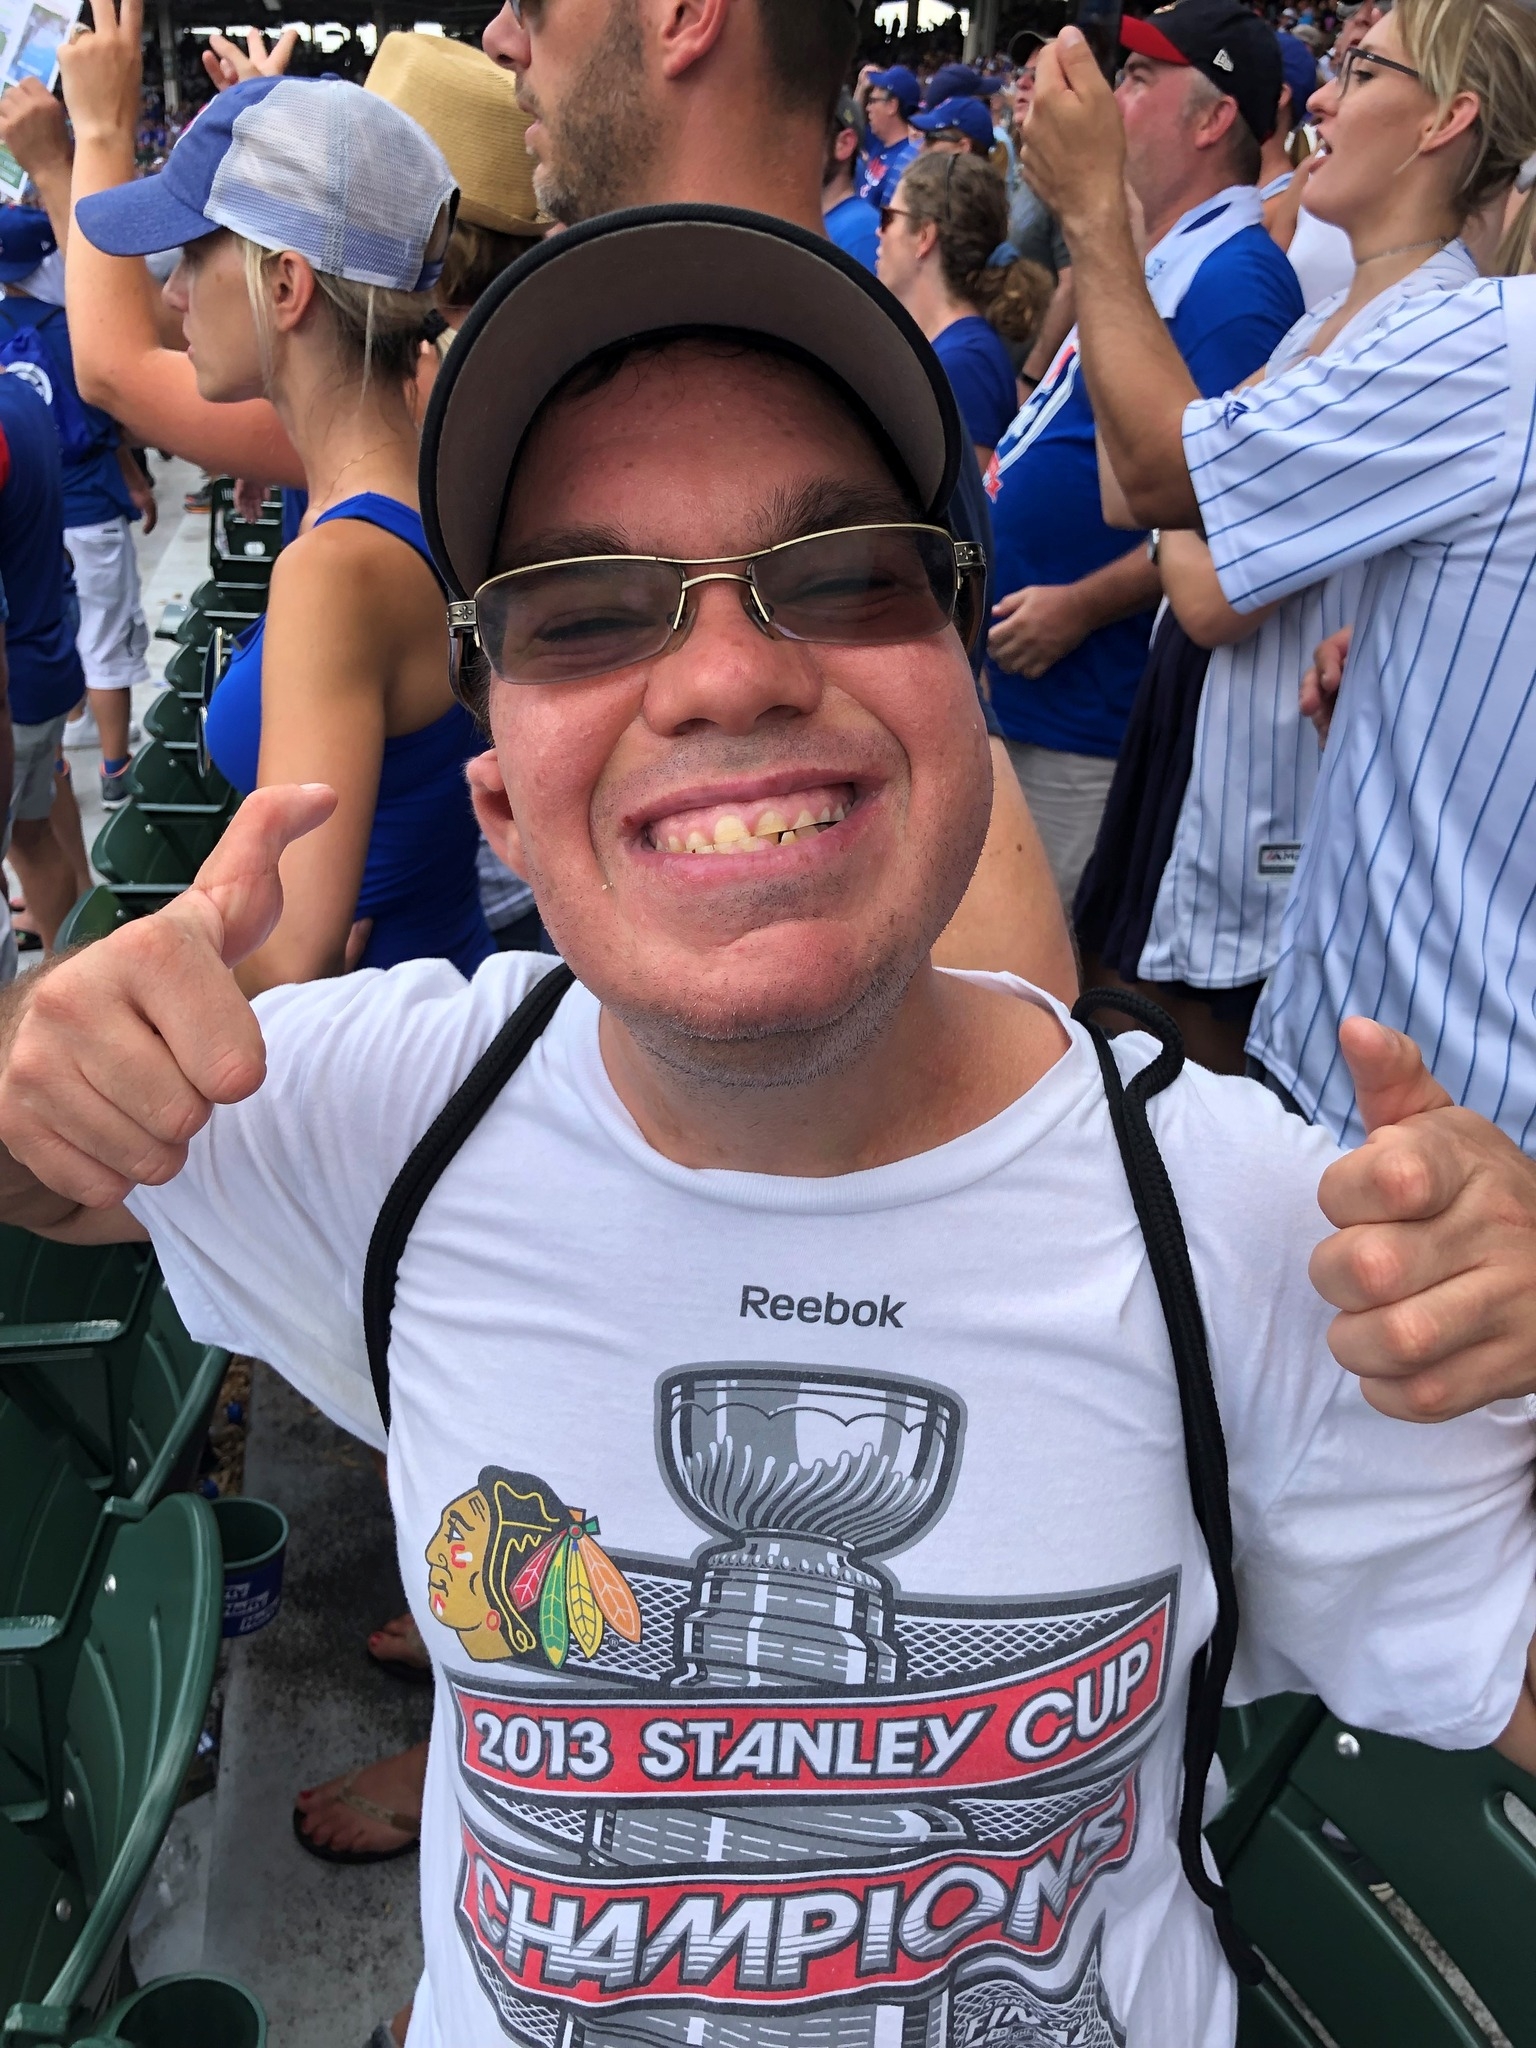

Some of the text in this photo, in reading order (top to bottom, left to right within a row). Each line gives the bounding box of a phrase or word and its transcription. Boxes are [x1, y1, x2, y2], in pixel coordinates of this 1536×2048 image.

[739, 1284, 907, 1329] Reebok
[473, 1638, 1153, 1781] 2013 STANLEY CUP
[473, 1786, 1127, 1988] CHAMPIONS
